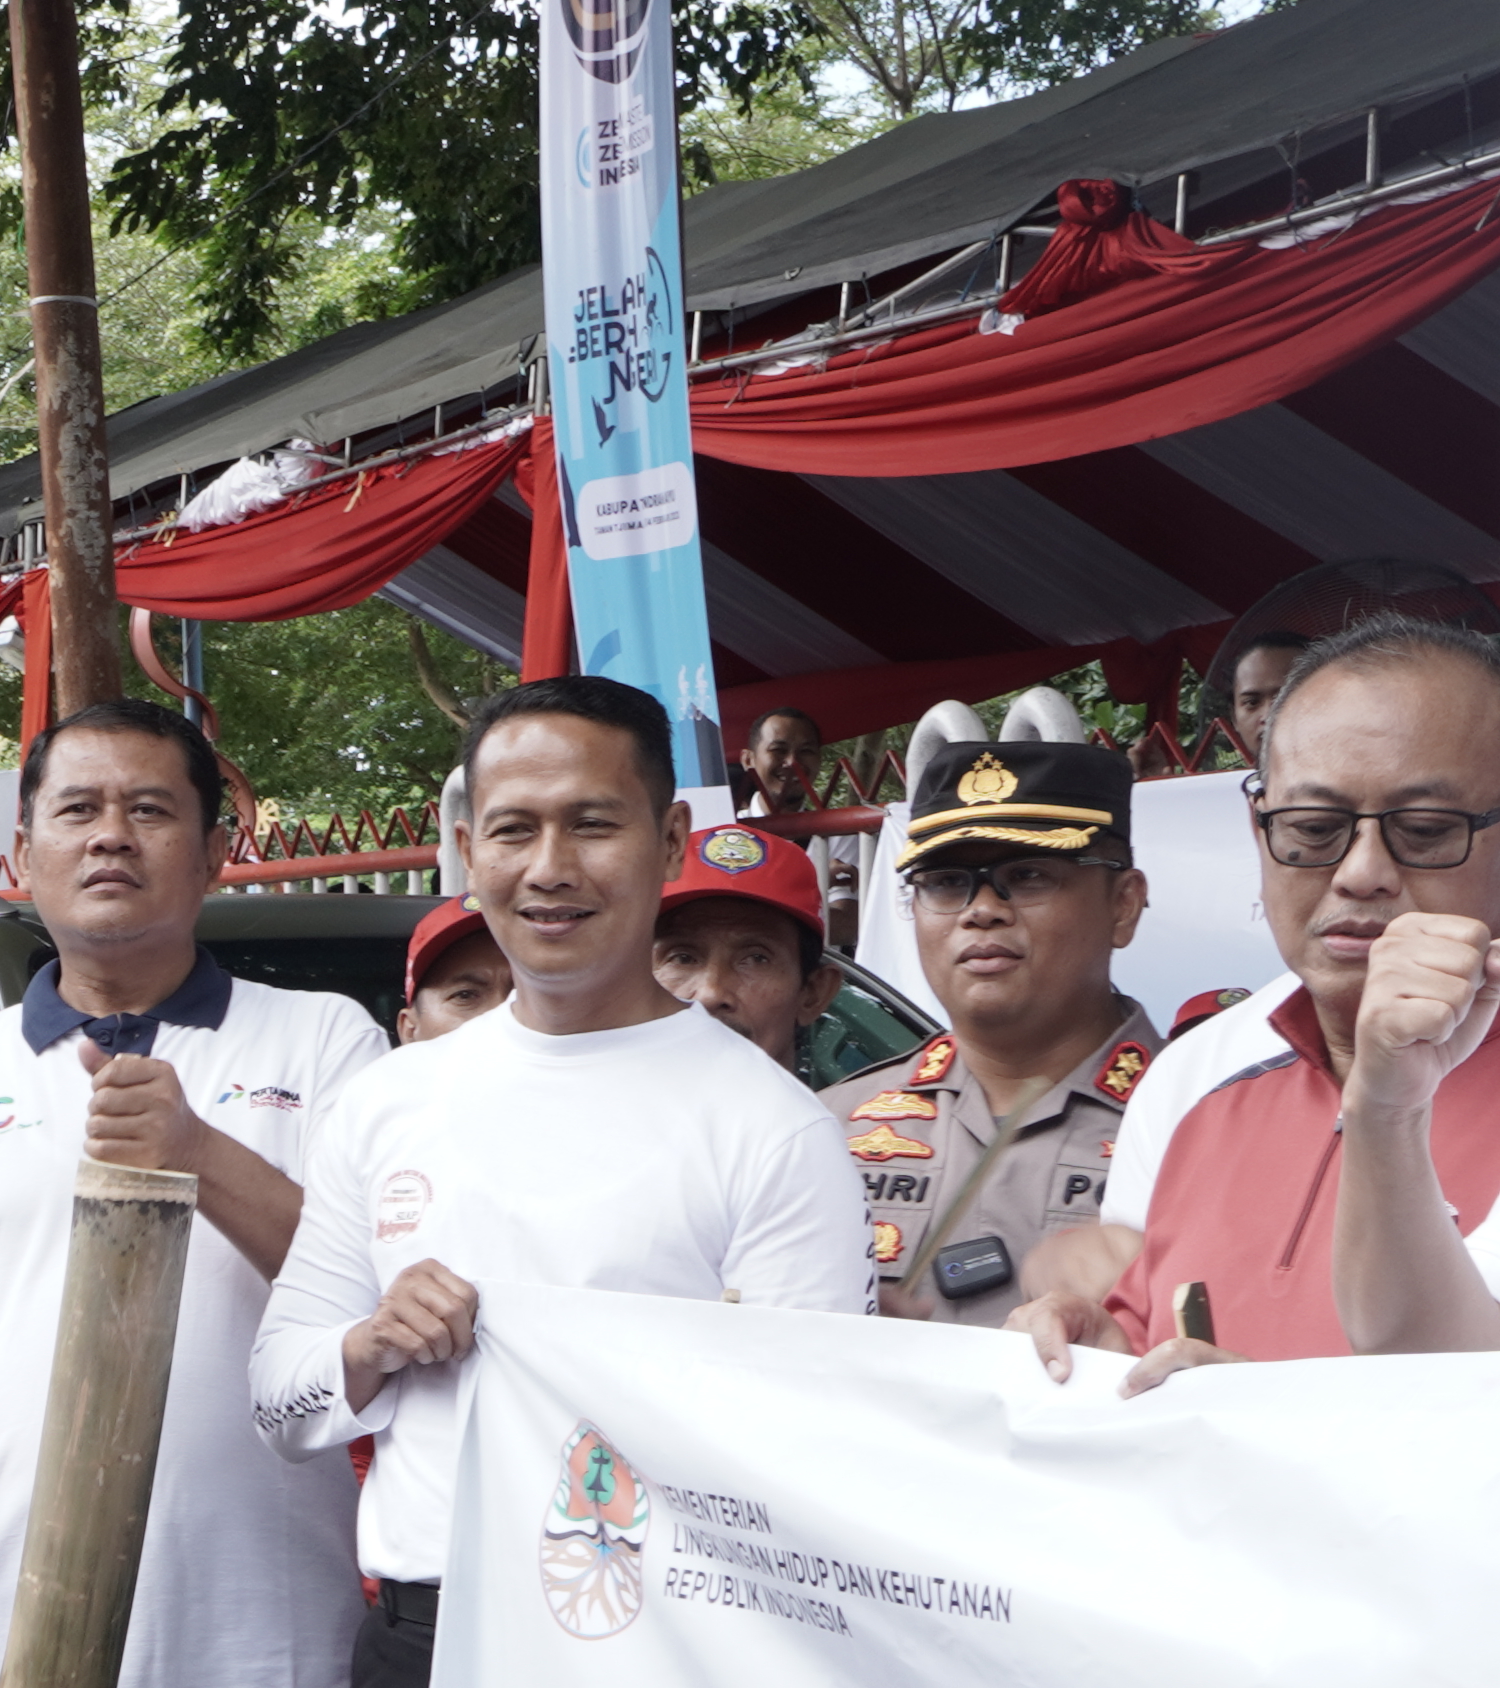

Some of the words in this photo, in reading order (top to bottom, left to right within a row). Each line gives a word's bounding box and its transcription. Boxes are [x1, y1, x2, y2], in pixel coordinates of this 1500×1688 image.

[664, 1567, 764, 1612] REPUBLIK
[763, 1586, 853, 1638] INDONESIA
[672, 1522, 774, 1575] LINGKUNGAN
[776, 1551, 829, 1589] HIDUP
[832, 1559, 877, 1600] DAN
[878, 1567, 1013, 1624] KEHUTANAN
